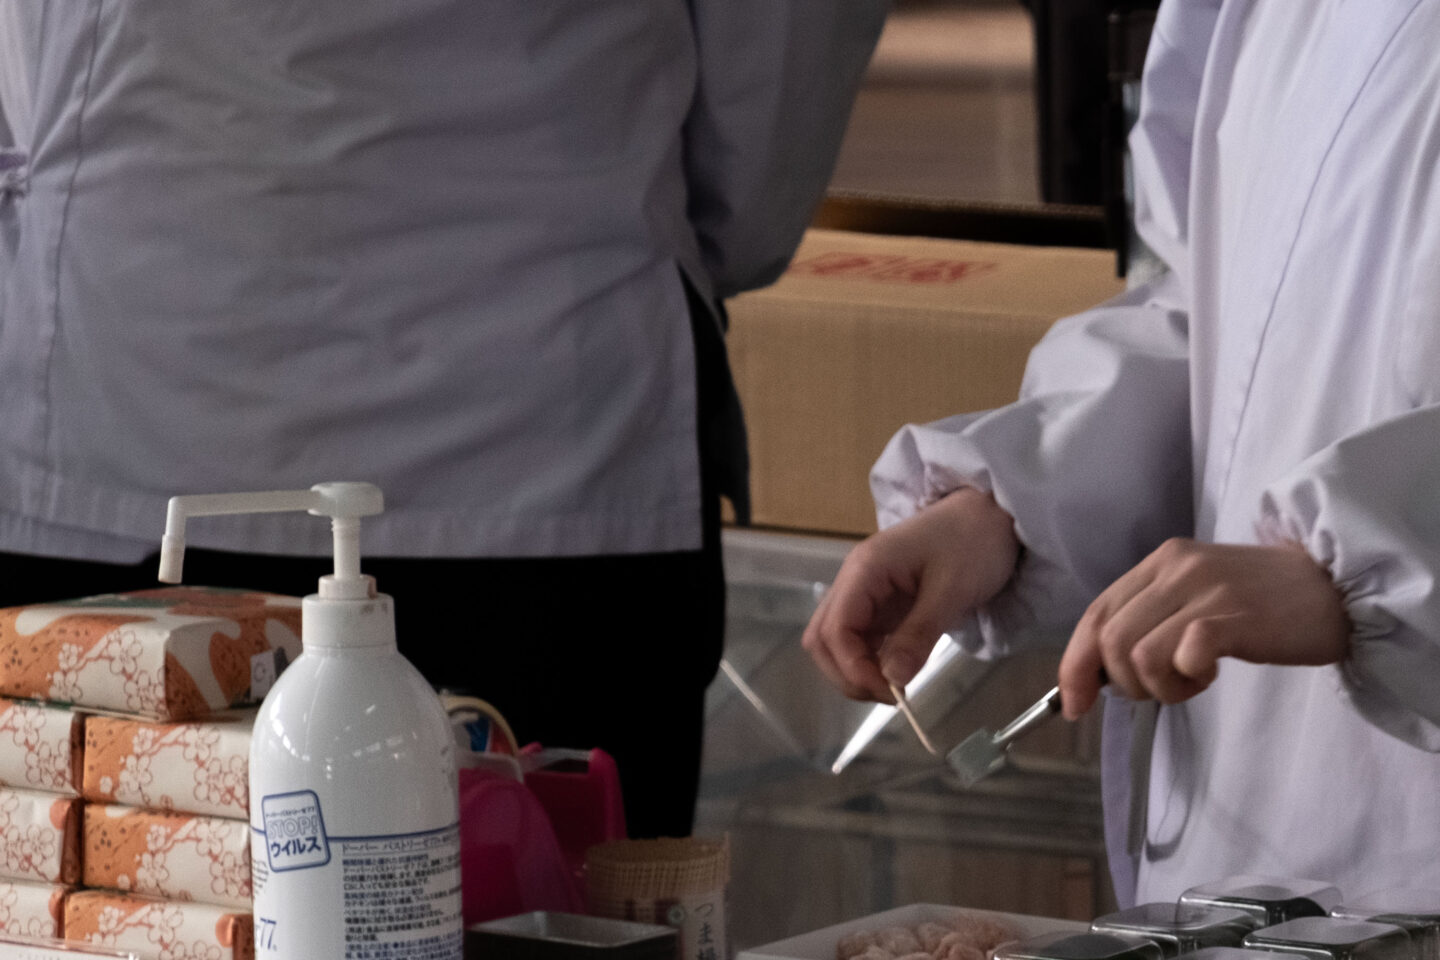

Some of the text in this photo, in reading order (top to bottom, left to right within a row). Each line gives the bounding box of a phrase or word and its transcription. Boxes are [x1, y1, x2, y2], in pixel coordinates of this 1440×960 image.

[268, 816, 319, 840] STOP!
[271, 837, 322, 859] ウイルス
